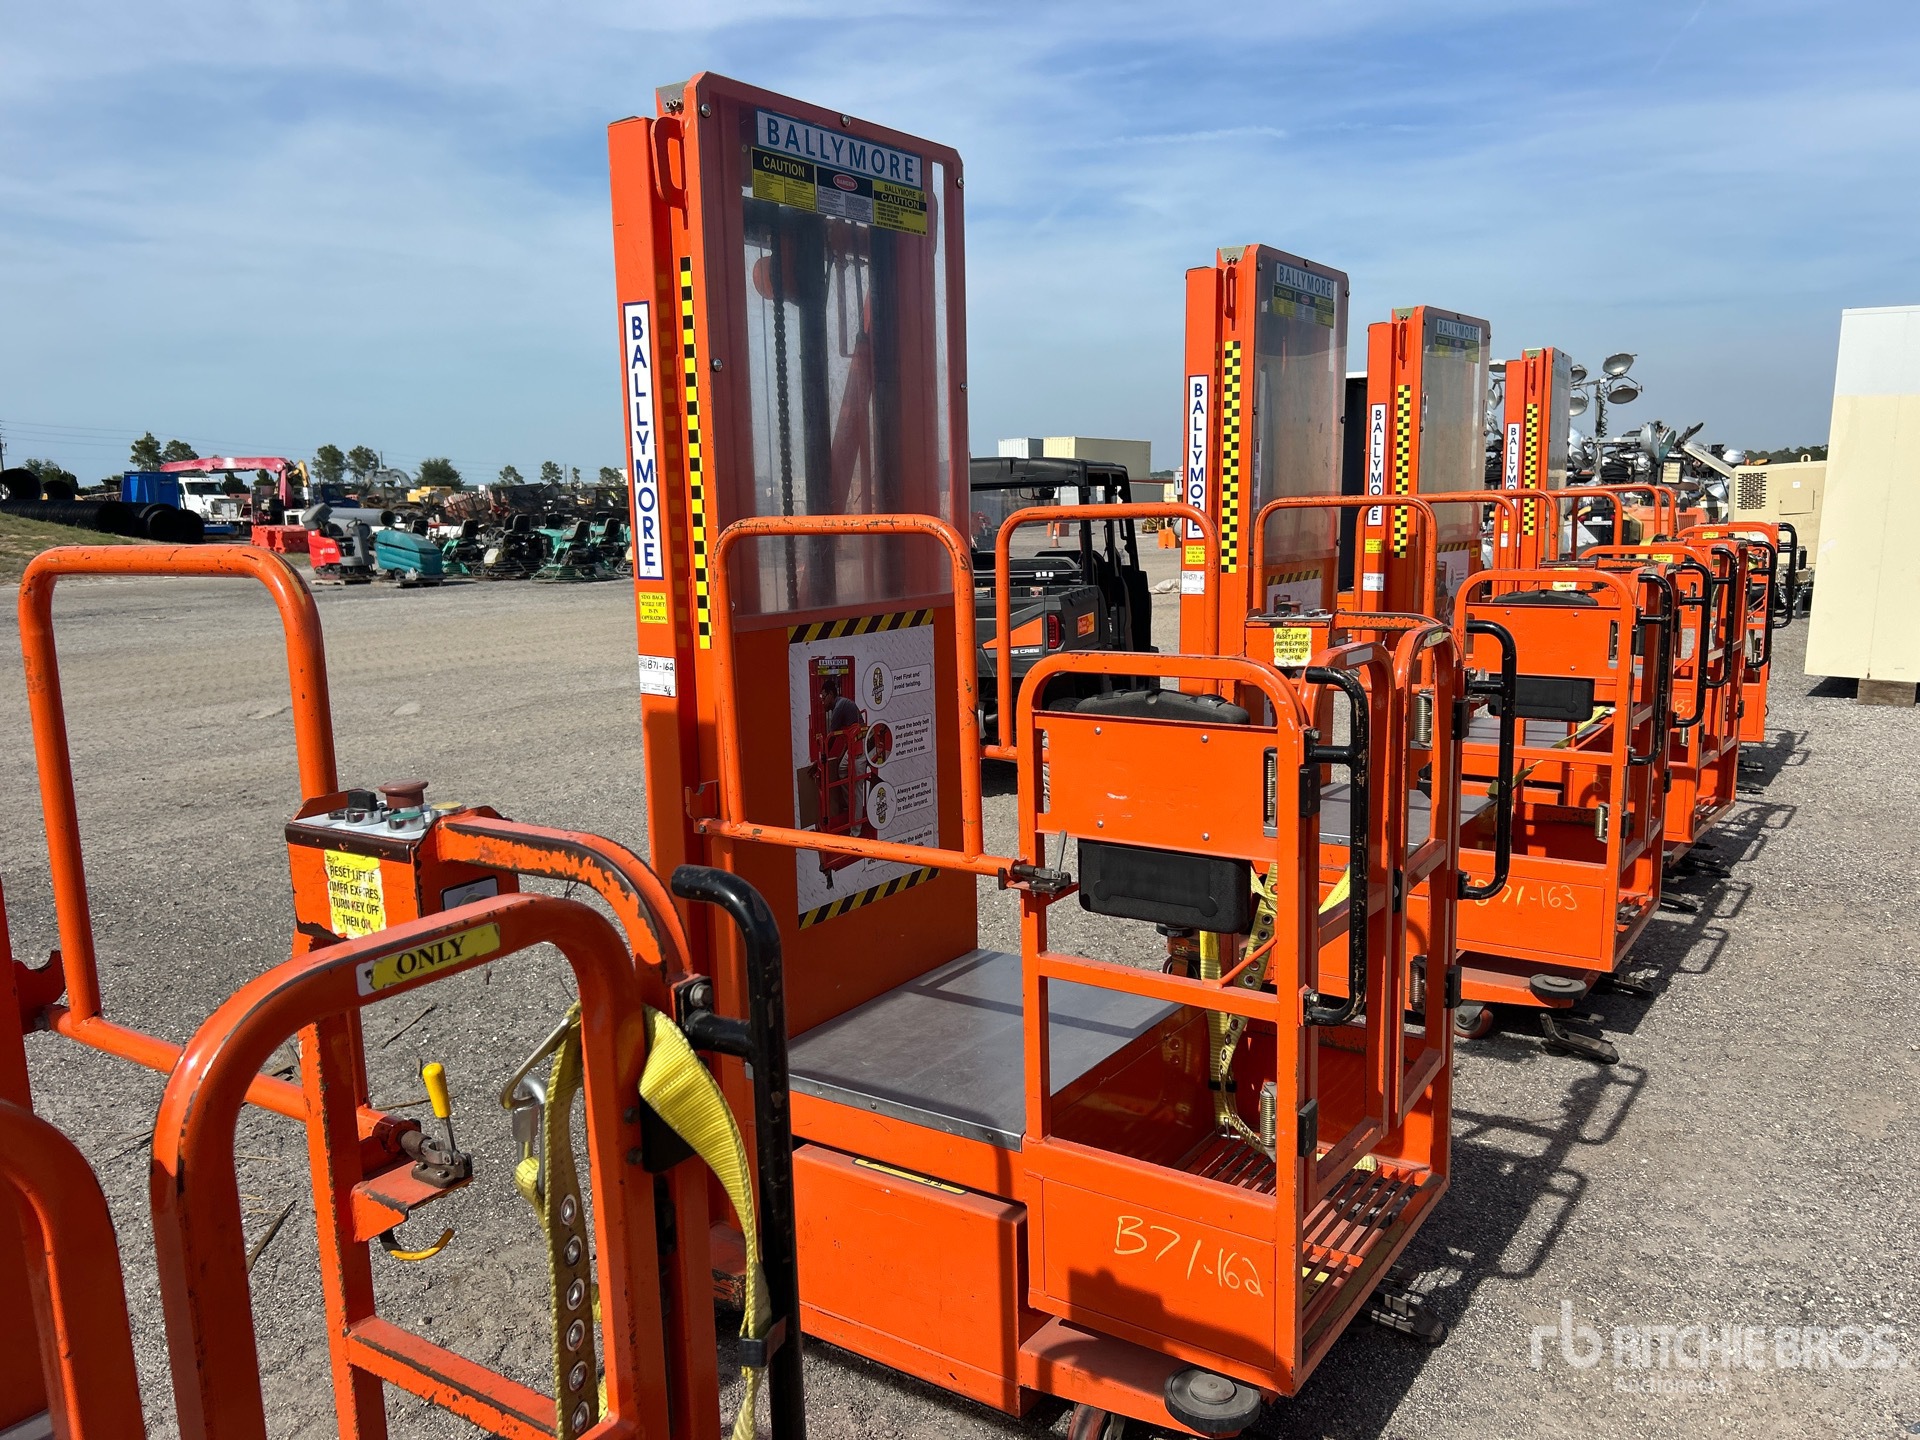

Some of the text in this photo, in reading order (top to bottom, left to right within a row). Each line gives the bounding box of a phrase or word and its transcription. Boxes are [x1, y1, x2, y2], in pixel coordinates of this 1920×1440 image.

[767, 118, 914, 182] BALLYMORE
[762, 156, 804, 178] CAUTION
[884, 184, 916, 198] BALLYMORE
[881, 194, 920, 210] CAUTION
[1280, 266, 1330, 296] BALLYMORE
[1438, 320, 1477, 340] BALLYMORE
[632, 316, 656, 566] BALLYMORE
[1371, 410, 1382, 520] BALLYMOE
[648, 660, 674, 671] B71-162
[915, 788, 932, 798] attached
[330, 866, 374, 882] RESET LIFT IF
[332, 897, 379, 915] TURN KEY OFF
[342, 914, 371, 929] THEN ON
[396, 934, 467, 974] ONLY
[1114, 1215, 1264, 1298] B71-162
